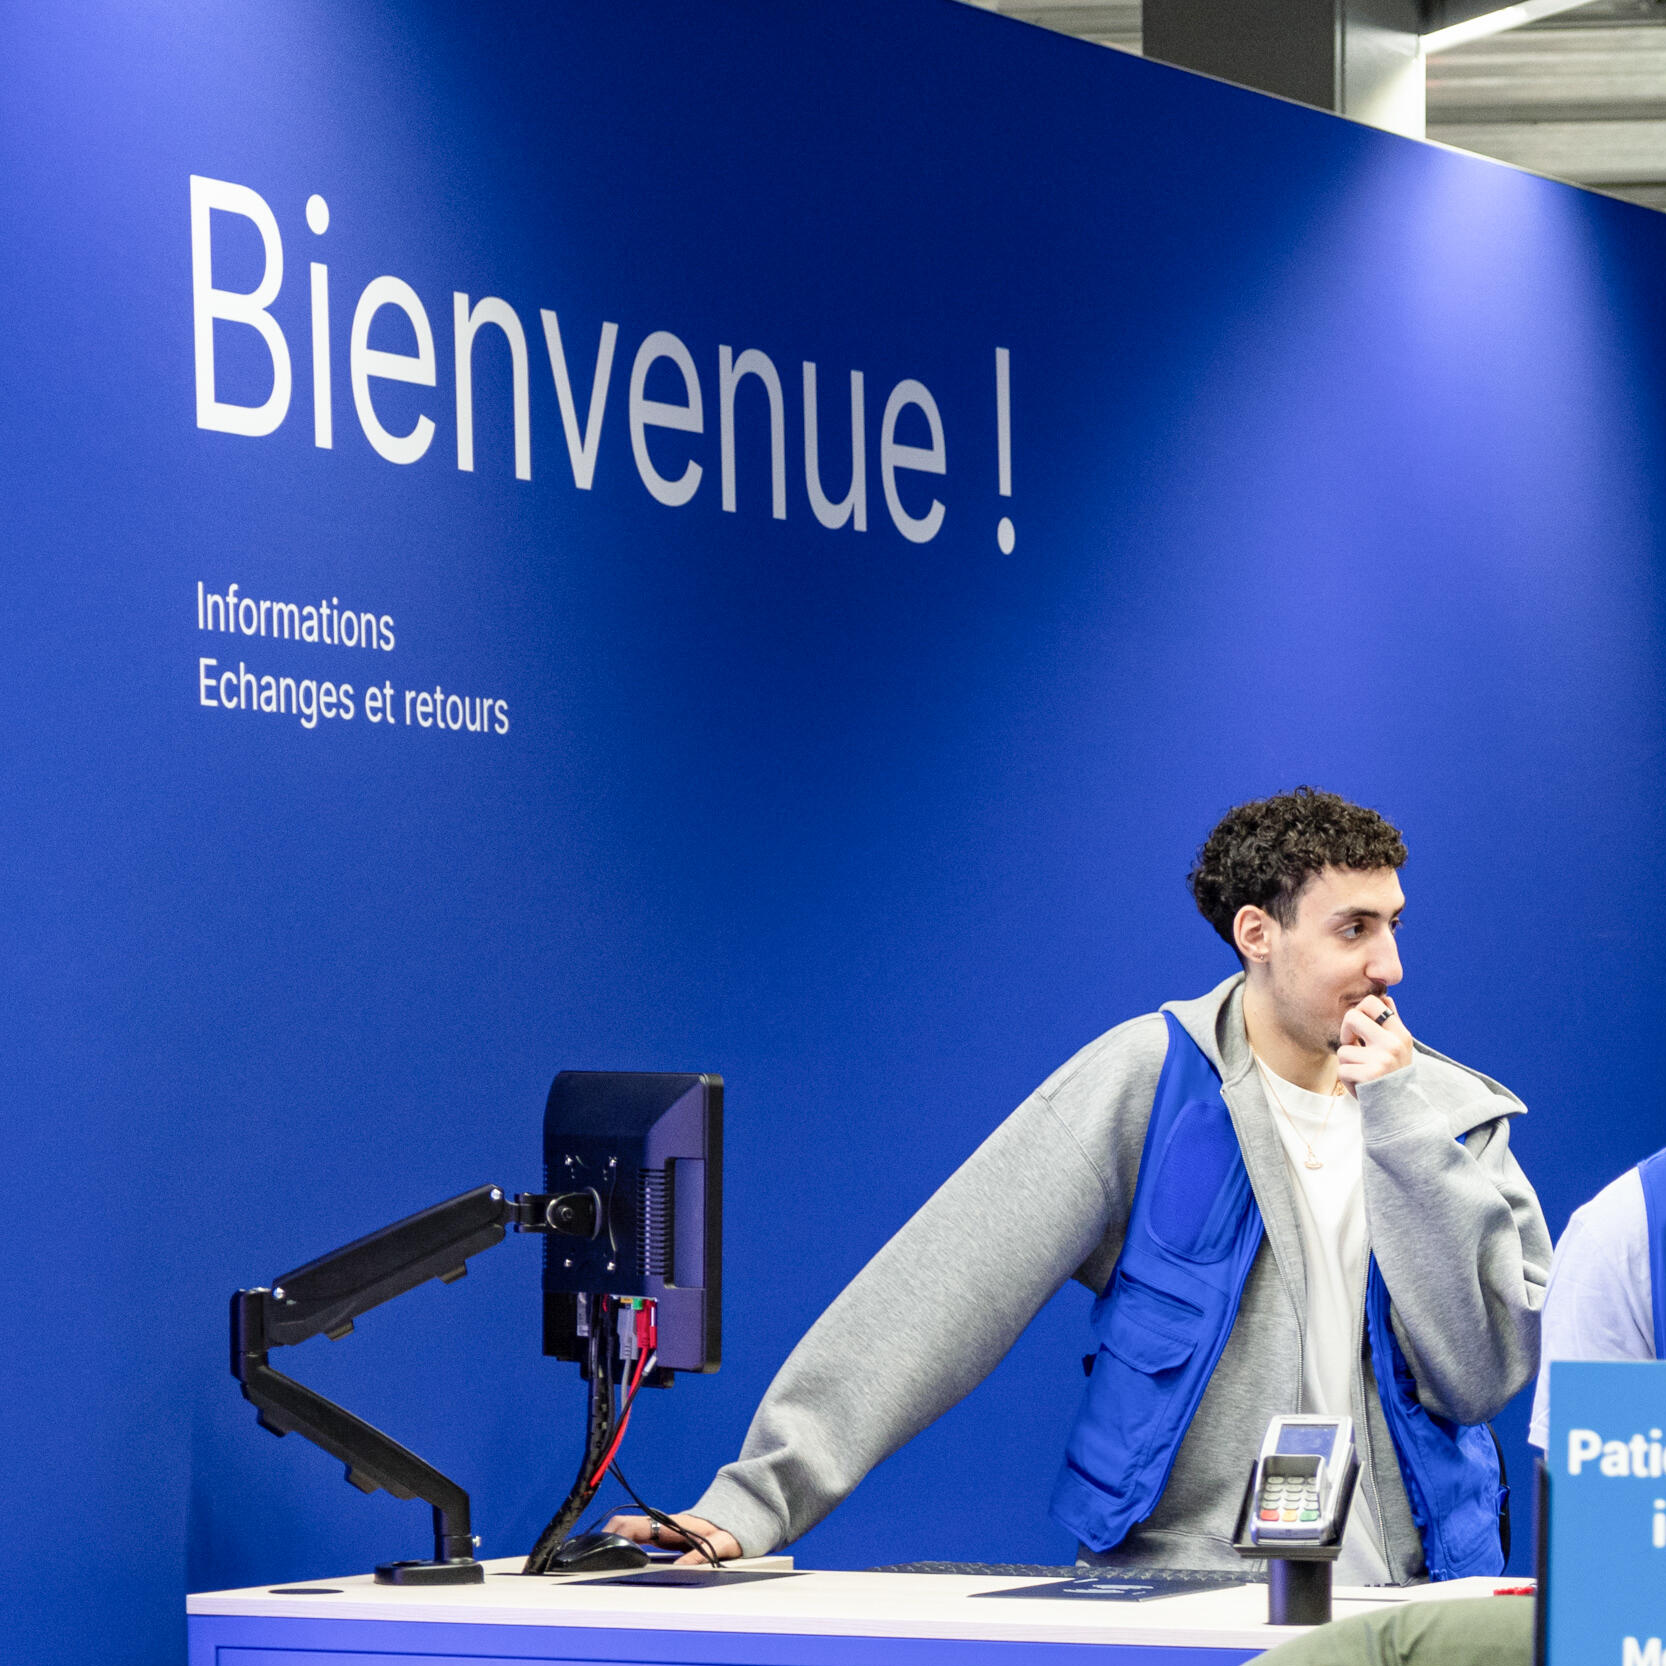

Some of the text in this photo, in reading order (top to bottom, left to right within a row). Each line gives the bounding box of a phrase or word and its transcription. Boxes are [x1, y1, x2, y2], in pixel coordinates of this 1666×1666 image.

[189, 173, 1016, 555] Bienvenue !
[197, 580, 395, 652] Informations
[199, 657, 509, 735] Echanges et retours
